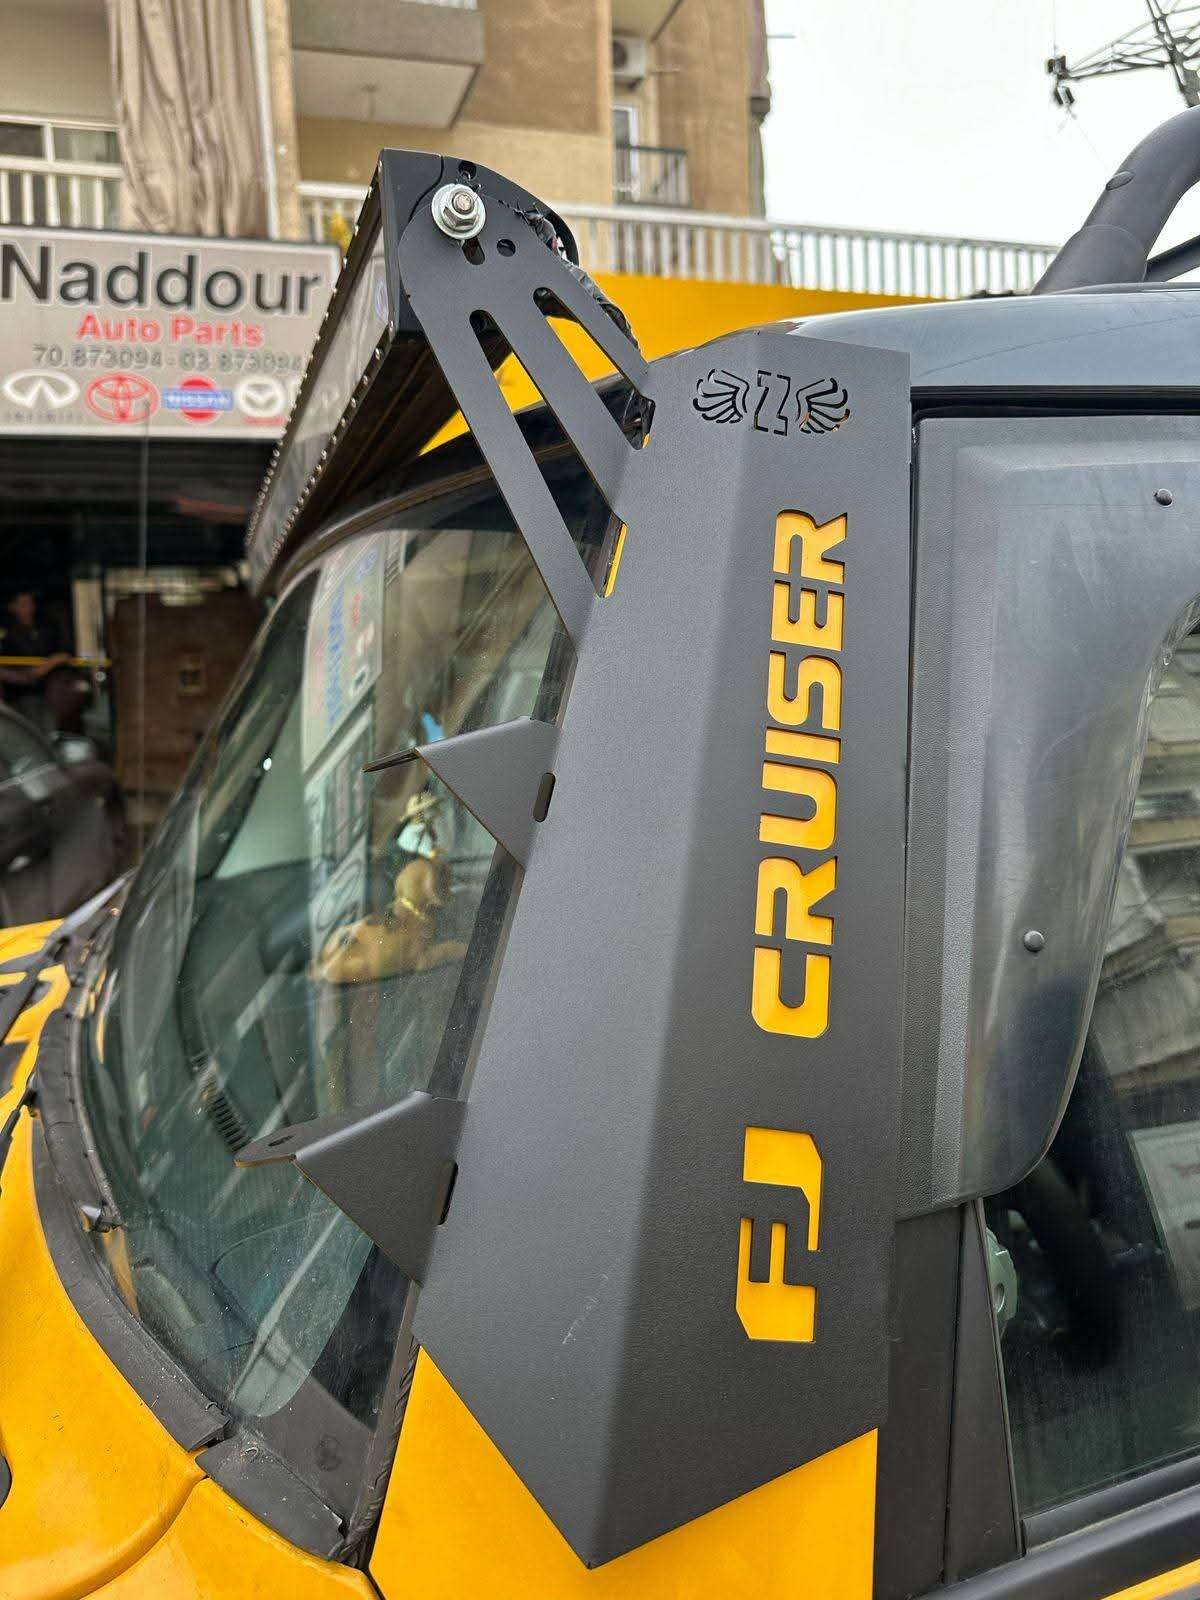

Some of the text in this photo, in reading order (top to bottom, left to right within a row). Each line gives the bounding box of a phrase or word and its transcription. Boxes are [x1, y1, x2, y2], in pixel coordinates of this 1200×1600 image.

[1, 243, 321, 314] Naddour
[76, 313, 264, 347] Auto Parts
[736, 508, 848, 1344] FJ CRUISER
